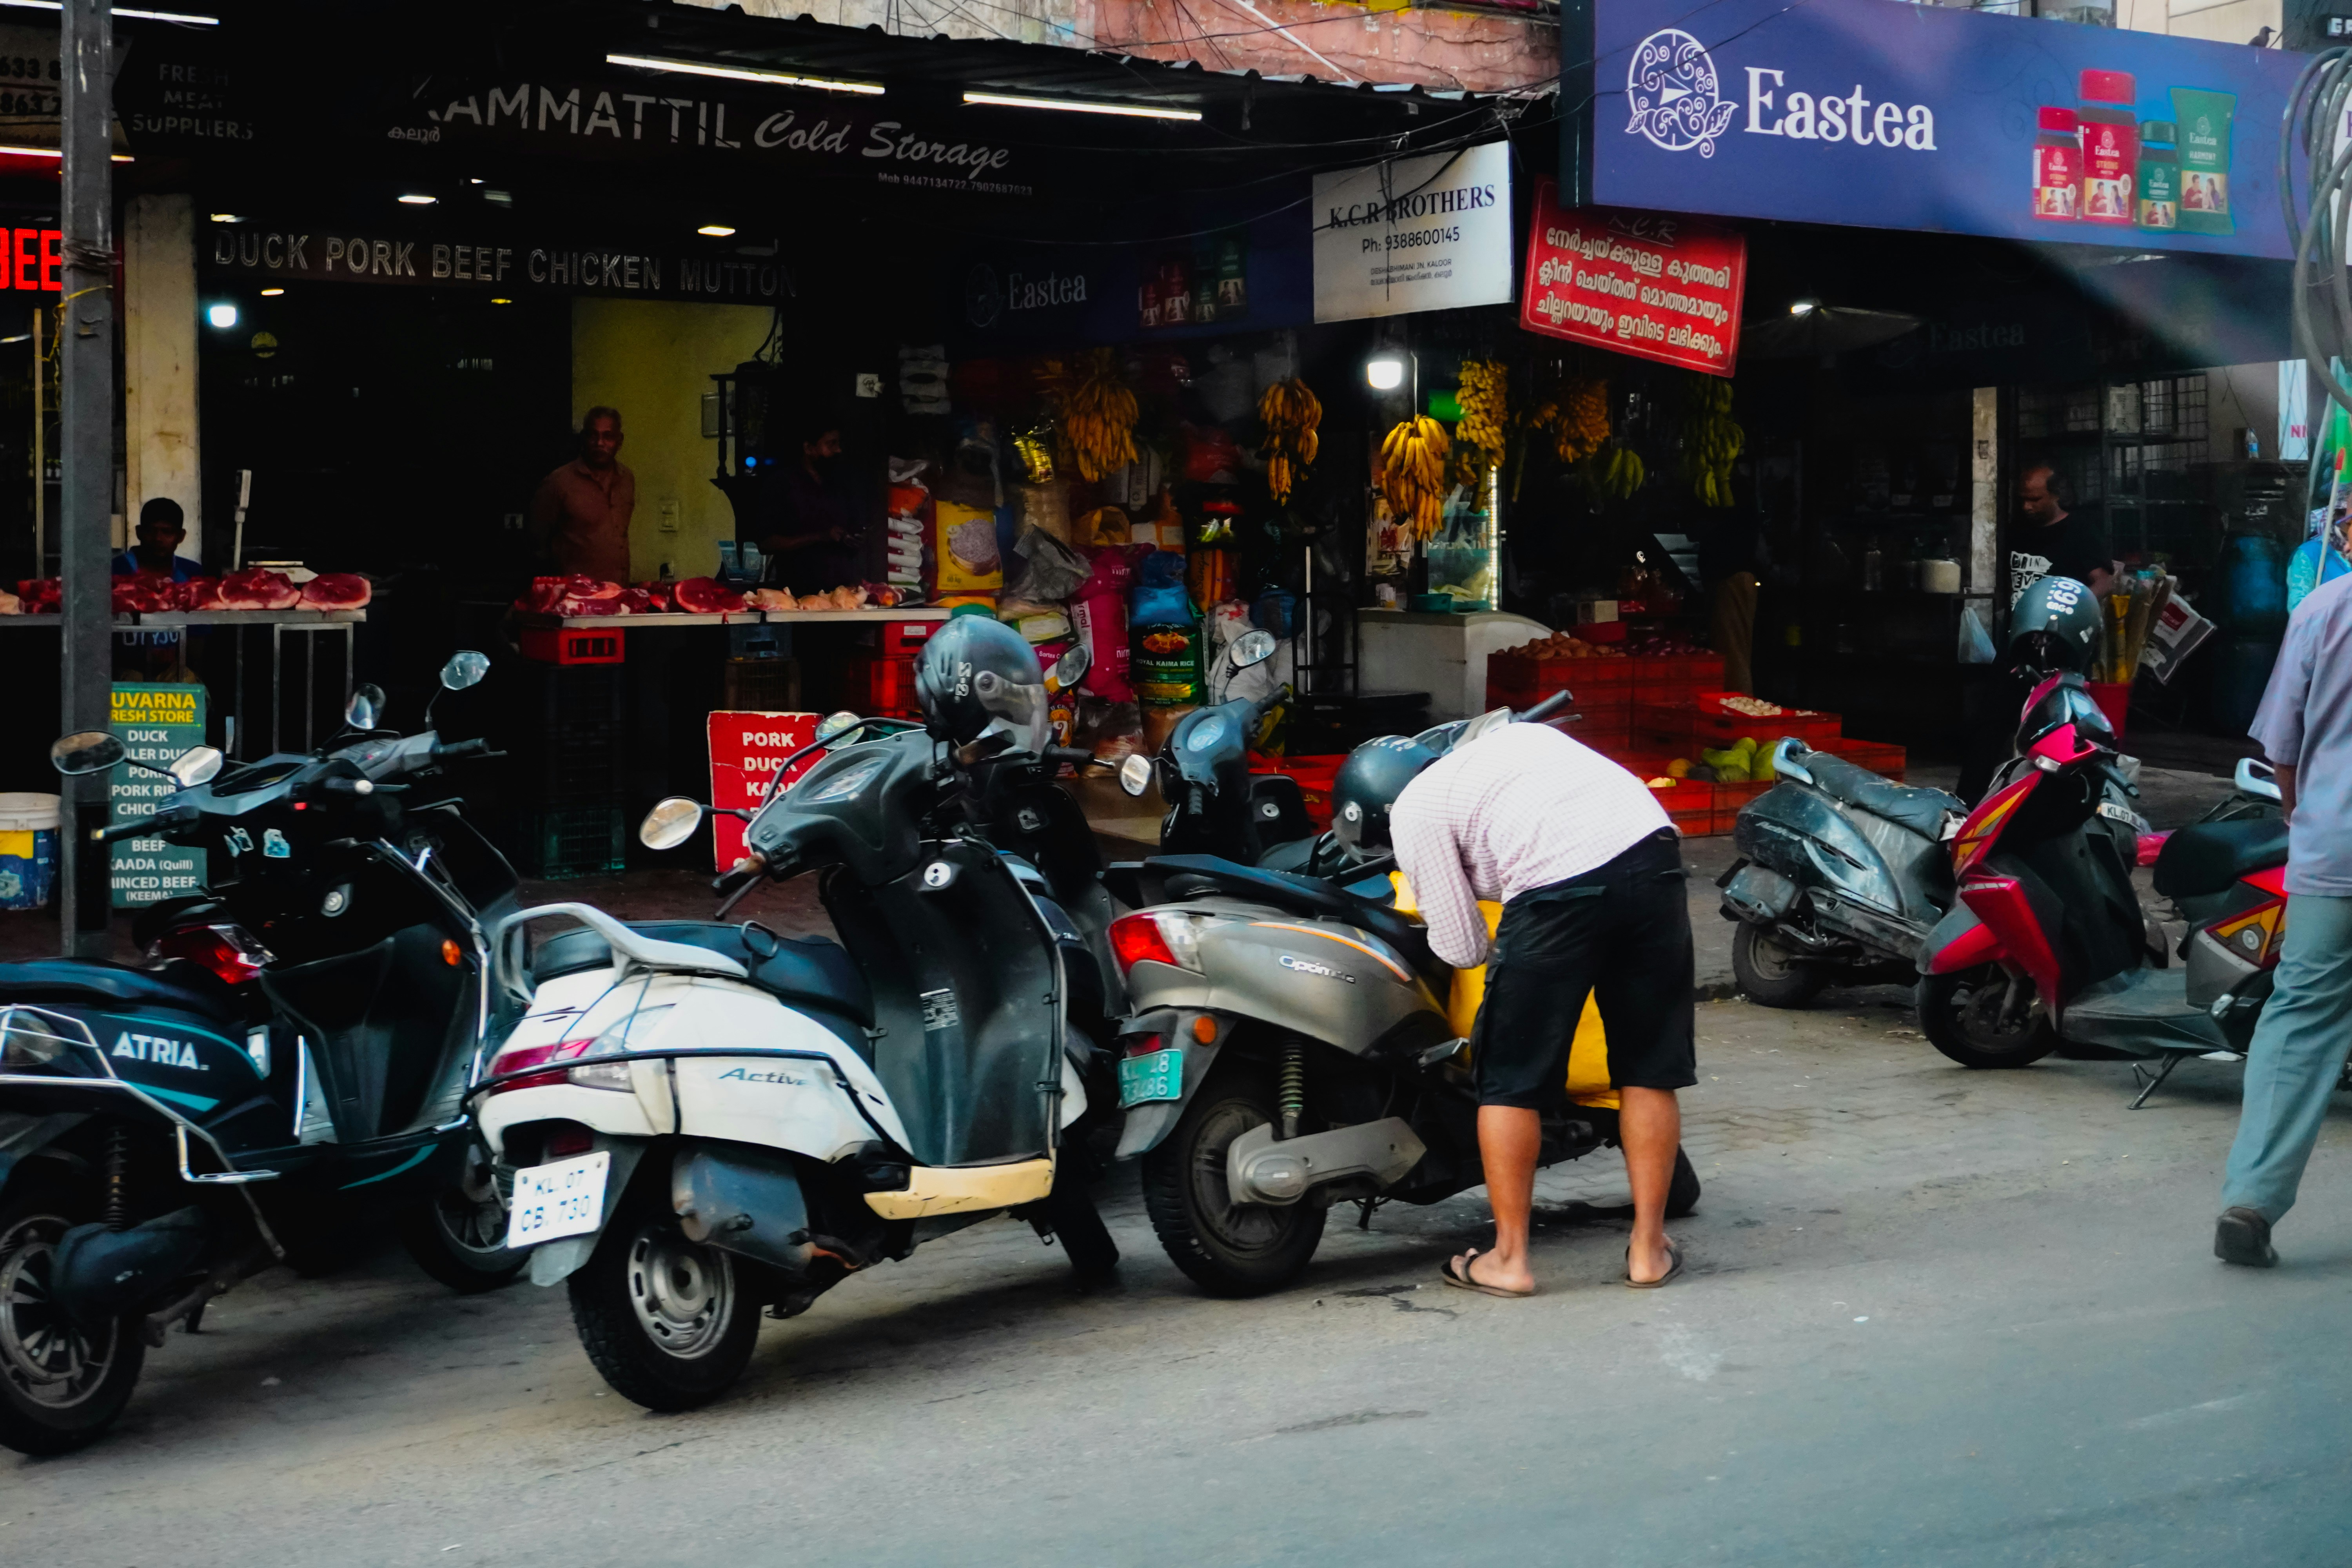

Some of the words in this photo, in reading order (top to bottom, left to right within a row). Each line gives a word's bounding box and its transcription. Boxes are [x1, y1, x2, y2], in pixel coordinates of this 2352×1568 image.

[159, 63, 229, 87] FRESH
[163, 90, 226, 110] MEAT
[1744, 66, 1937, 151] Eastea
[132, 113, 254, 140] SUPPLIERS
[753, 109, 852, 154] Cold
[861, 121, 1010, 180] Storage
[878, 172, 900, 183] Mob
[1386, 184, 1495, 221] BROTHERS
[1362, 238, 1381, 253] Ph:
[1385, 226, 1460, 251] 9388600145
[215, 230, 309, 270] DUCK
[326, 236, 416, 277] PORK
[432, 243, 512, 281] BEEF
[528, 249, 661, 290] CHICKEN
[680, 259, 796, 298] MUTTON
[1427, 258, 1452, 268] KALOOR
[1667, 259, 1731, 289] കുത്തരി
[1009, 270, 1087, 310] Eastea
[1641, 285, 1729, 327] മൊത്തമായും
[1617, 313, 1666, 339] ഇവിടെ
[149, 710, 194, 723] STORE
[127, 729, 169, 742] DUCK
[742, 731, 796, 748] PORK
[111, 784, 151, 797] PORK
[131, 840, 167, 852] BEEF
[159, 859, 194, 871] (Quill)
[162, 876, 196, 888] BEEF
[111, 1031, 199, 1070] ATRIA
[566, 1169, 585, 1188] 07
[558, 1194, 590, 1223] 730
